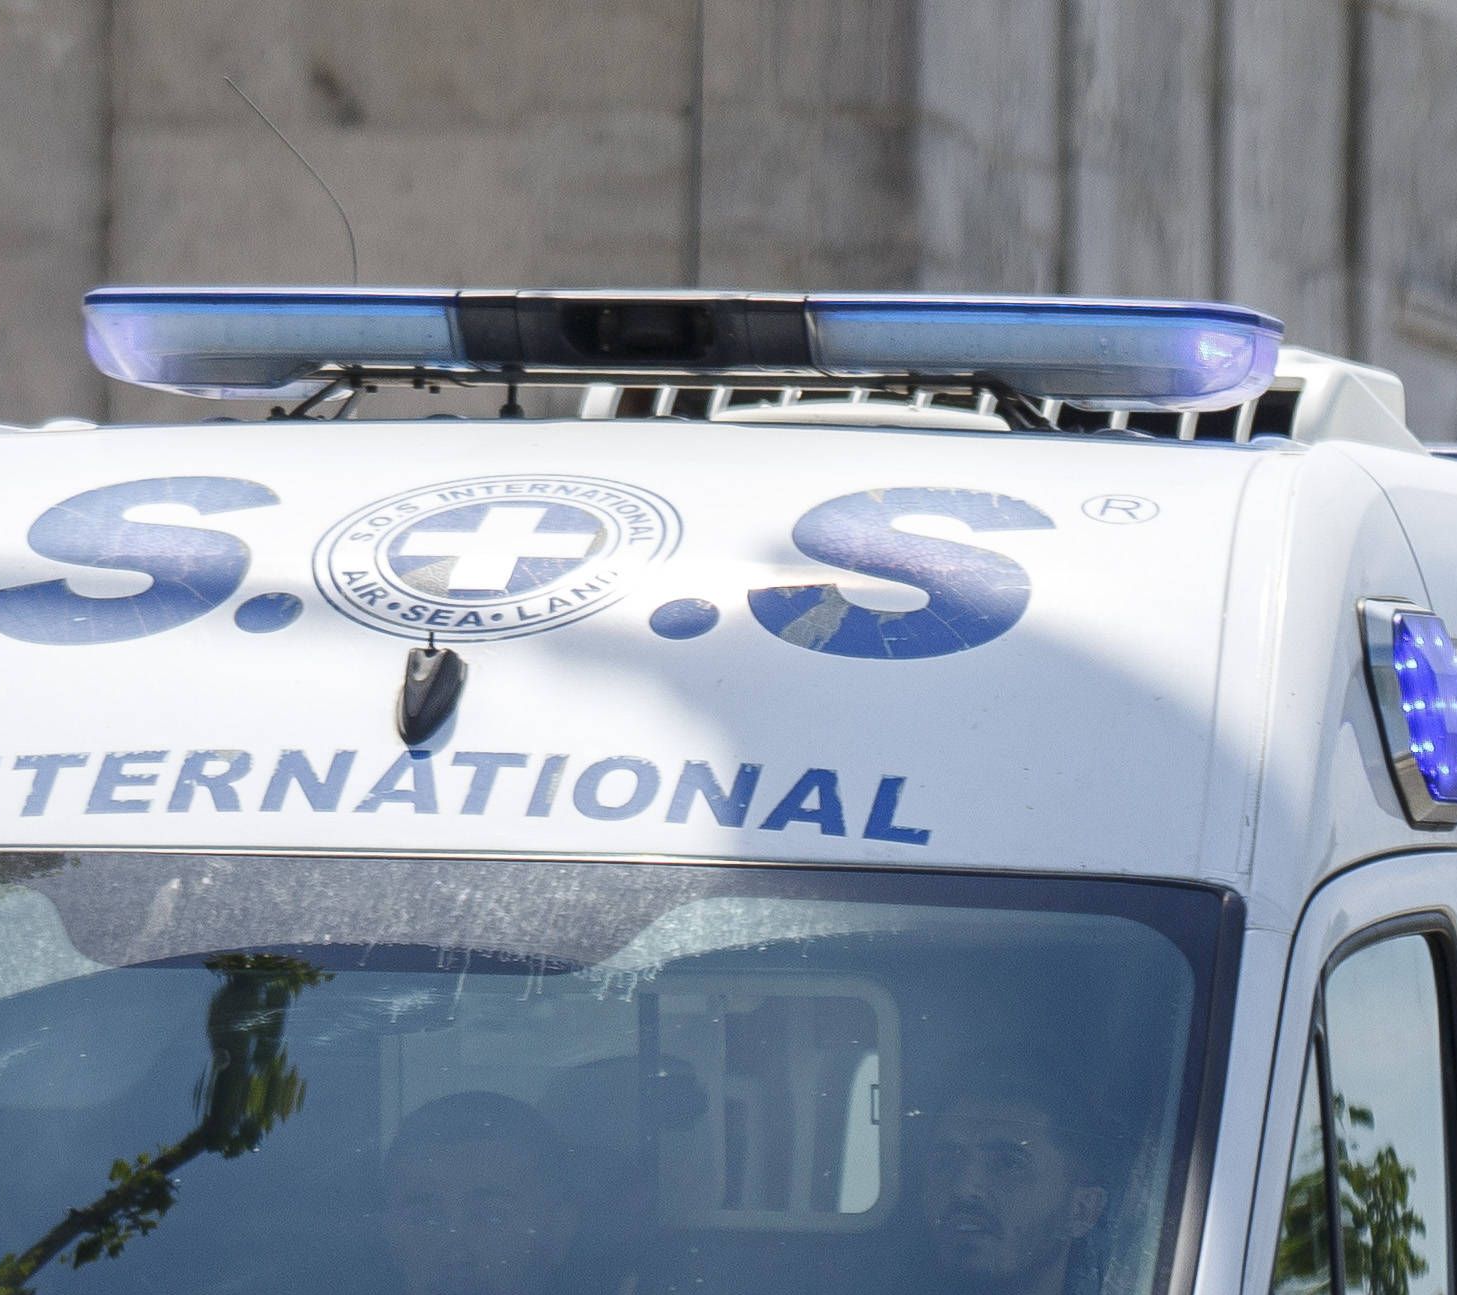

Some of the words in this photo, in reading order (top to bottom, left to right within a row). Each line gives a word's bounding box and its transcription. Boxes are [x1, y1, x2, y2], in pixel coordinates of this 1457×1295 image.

[436, 483, 655, 545] INTERNATIONAL
[341, 570, 388, 609] AIR
[401, 604, 486, 628] SEA
